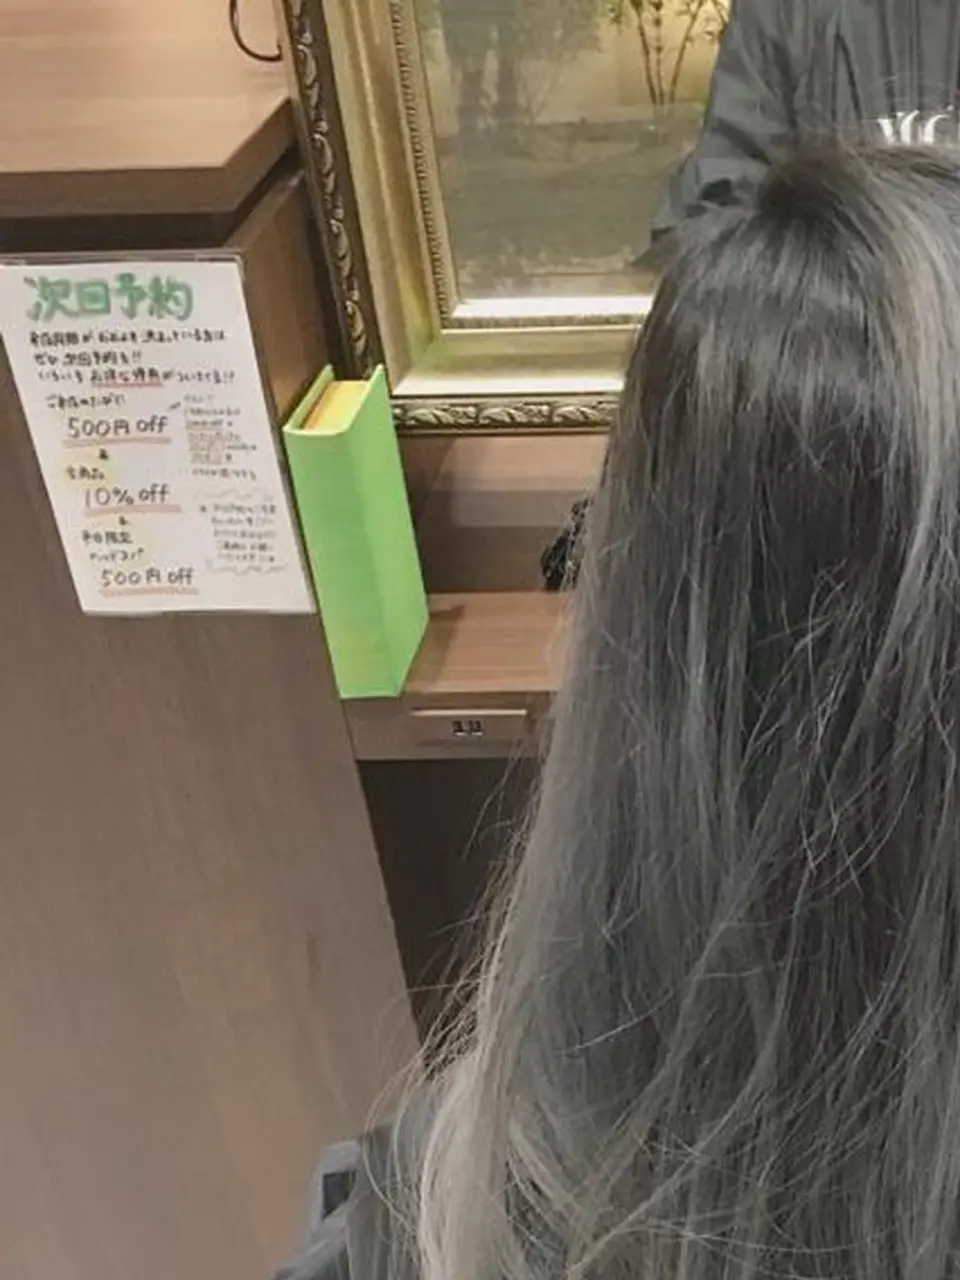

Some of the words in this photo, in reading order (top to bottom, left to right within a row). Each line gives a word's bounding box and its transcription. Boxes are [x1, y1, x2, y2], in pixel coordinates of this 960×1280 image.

[24, 272, 193, 321] 次回予約
[67, 417, 130, 438] 500円
[136, 416, 168, 433] off
[85, 486, 134, 507] 10%
[139, 484, 169, 501] off
[101, 568, 161, 587] 500円
[168, 568, 194, 585] off
